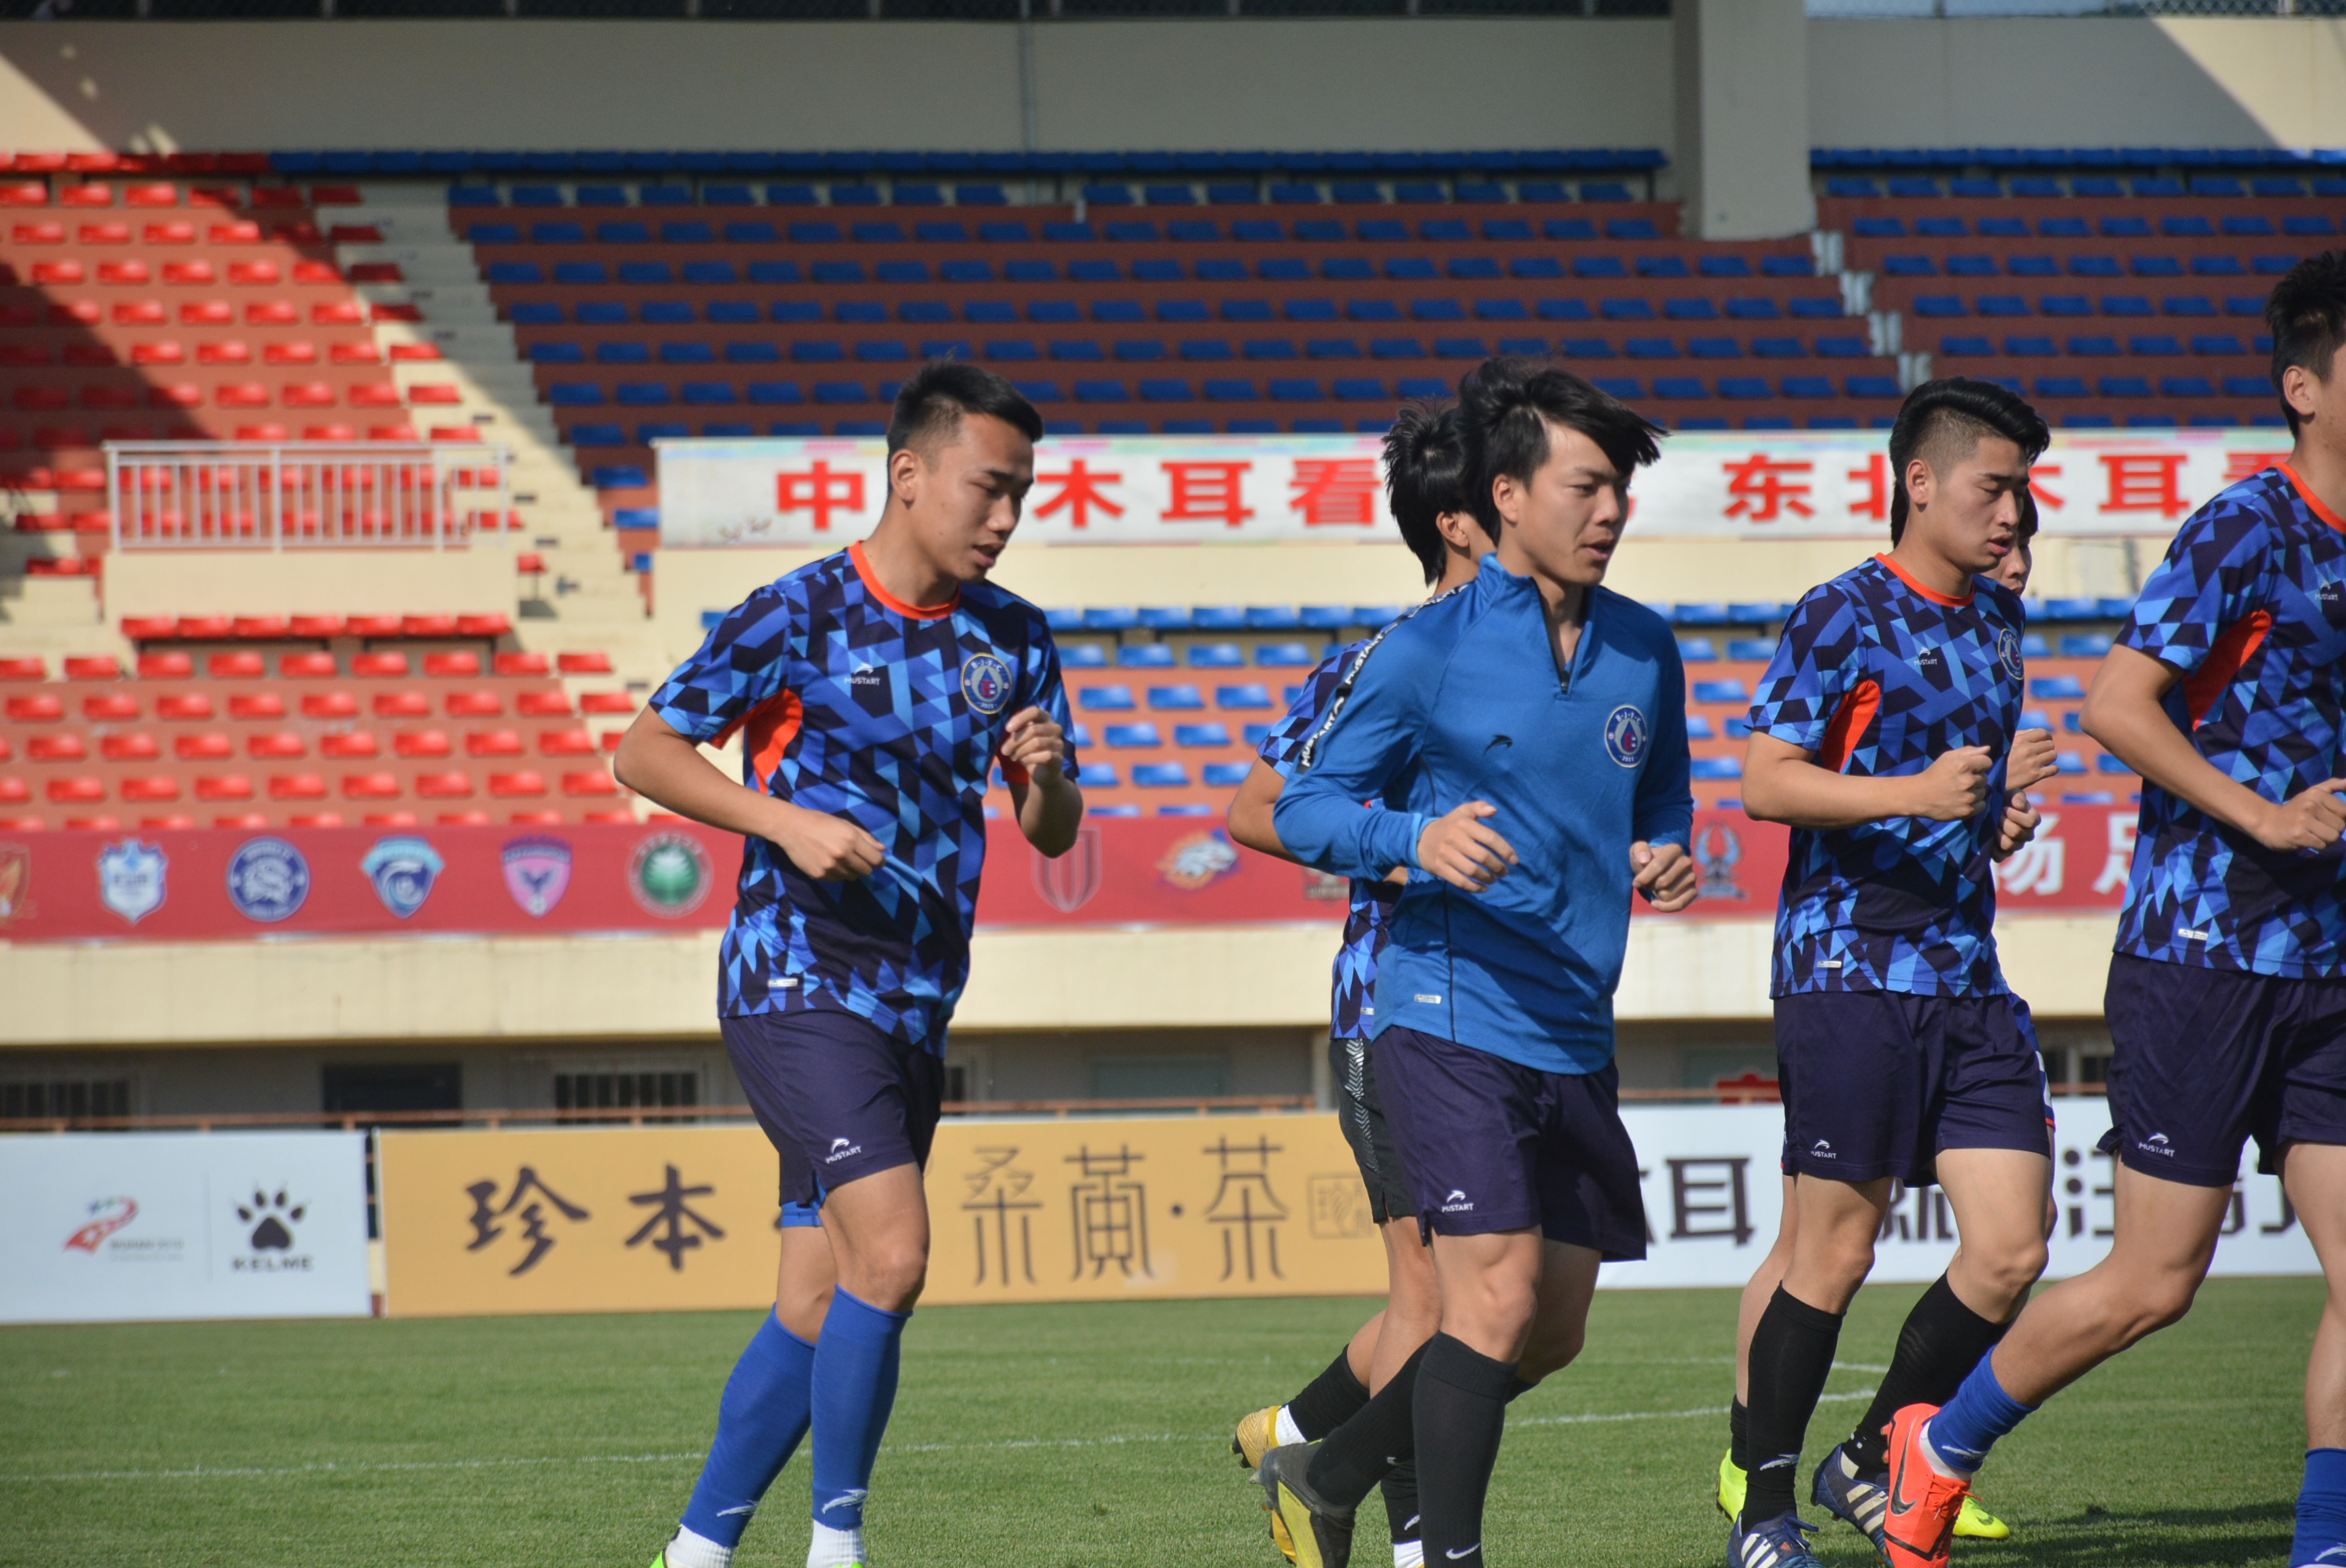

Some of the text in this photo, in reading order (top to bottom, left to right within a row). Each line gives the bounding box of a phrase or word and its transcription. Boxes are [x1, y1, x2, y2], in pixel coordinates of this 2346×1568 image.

[777, 460, 865, 531] 中
[1033, 457, 1382, 529] 木耳看
[844, 677, 881, 686] MUSTART
[1301, 712, 1336, 767] MUSTART
[825, 1145, 862, 1164] MUSTART
[2138, 1142, 2175, 1157] MUSTART
[1442, 1203, 1474, 1213] MUSTART
[464, 1163, 726, 1278] 珍本
[232, 1256, 315, 1272] KELME
